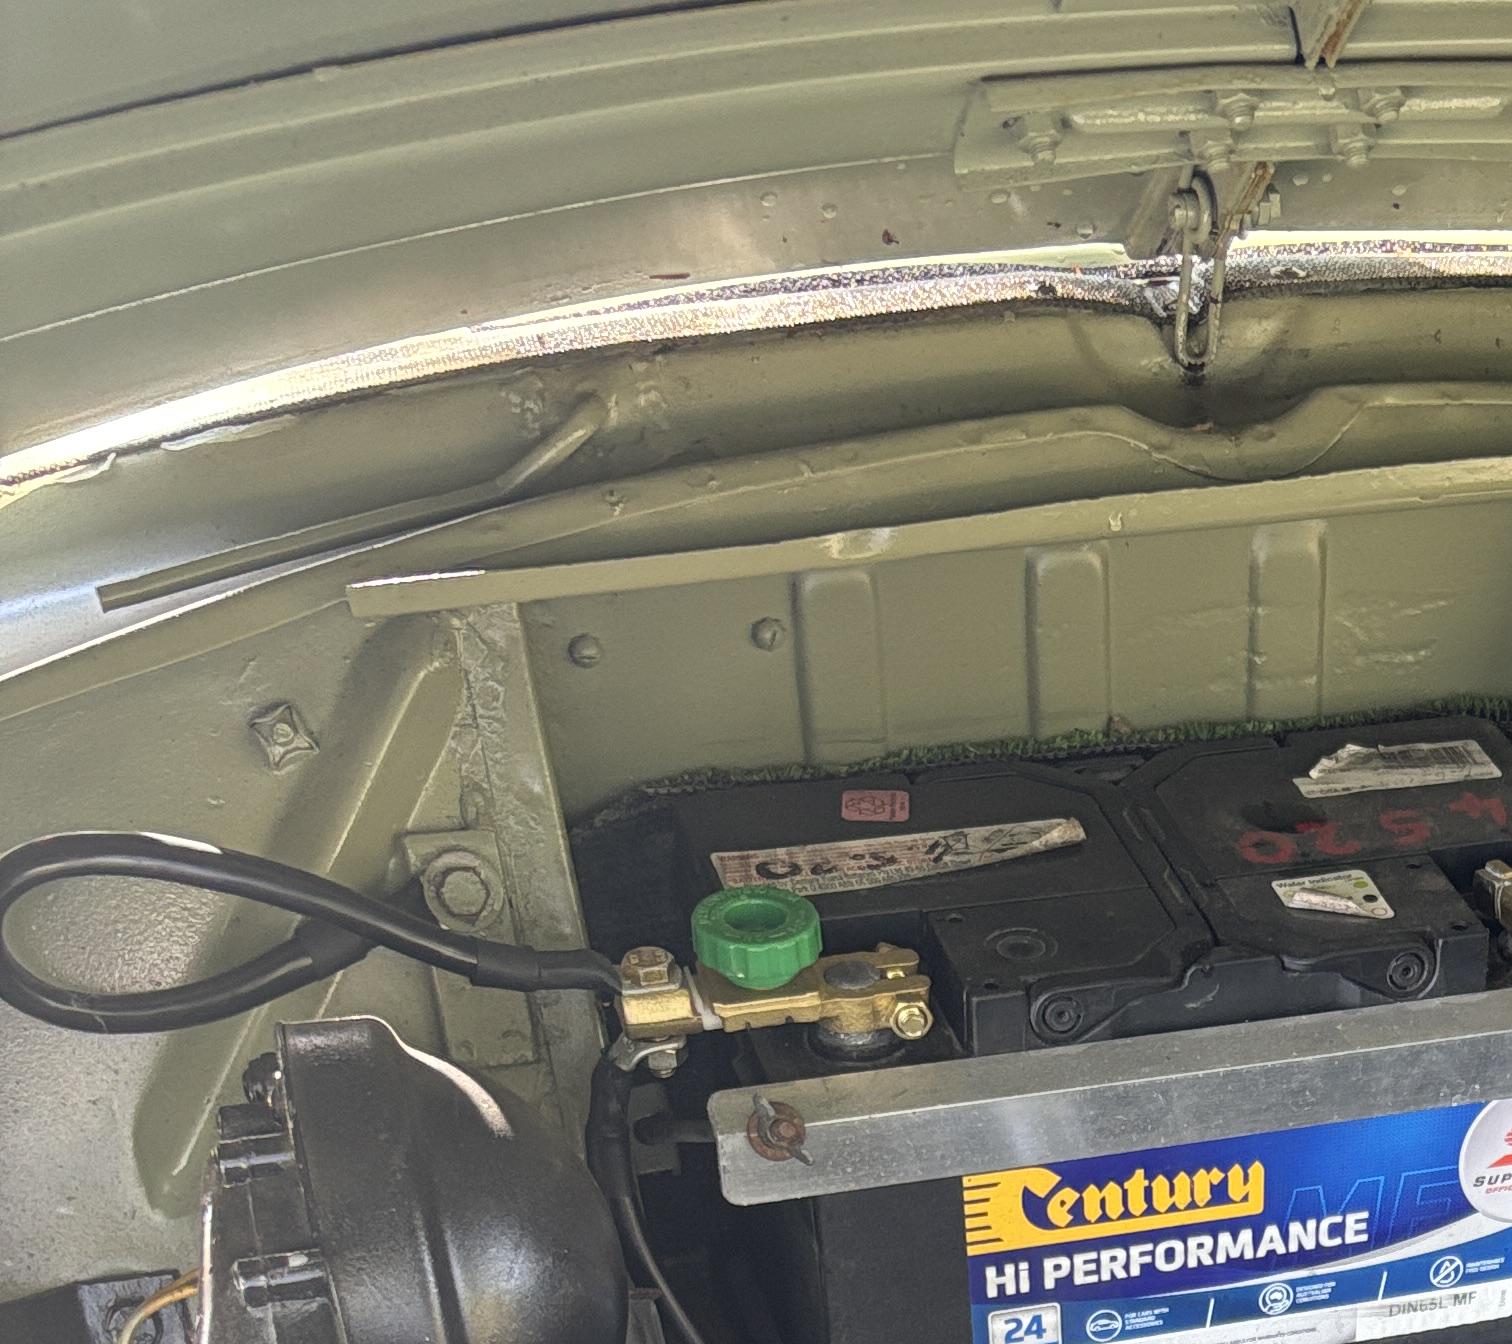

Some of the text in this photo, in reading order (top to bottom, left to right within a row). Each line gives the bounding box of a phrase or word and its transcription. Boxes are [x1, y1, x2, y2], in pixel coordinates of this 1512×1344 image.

[963, 1160, 1265, 1256] Century
[985, 1210, 1370, 1298] Hi PERFORMANCE
[1453, 1290, 1477, 1307] MF
[1003, 1313, 1047, 1344] 24
